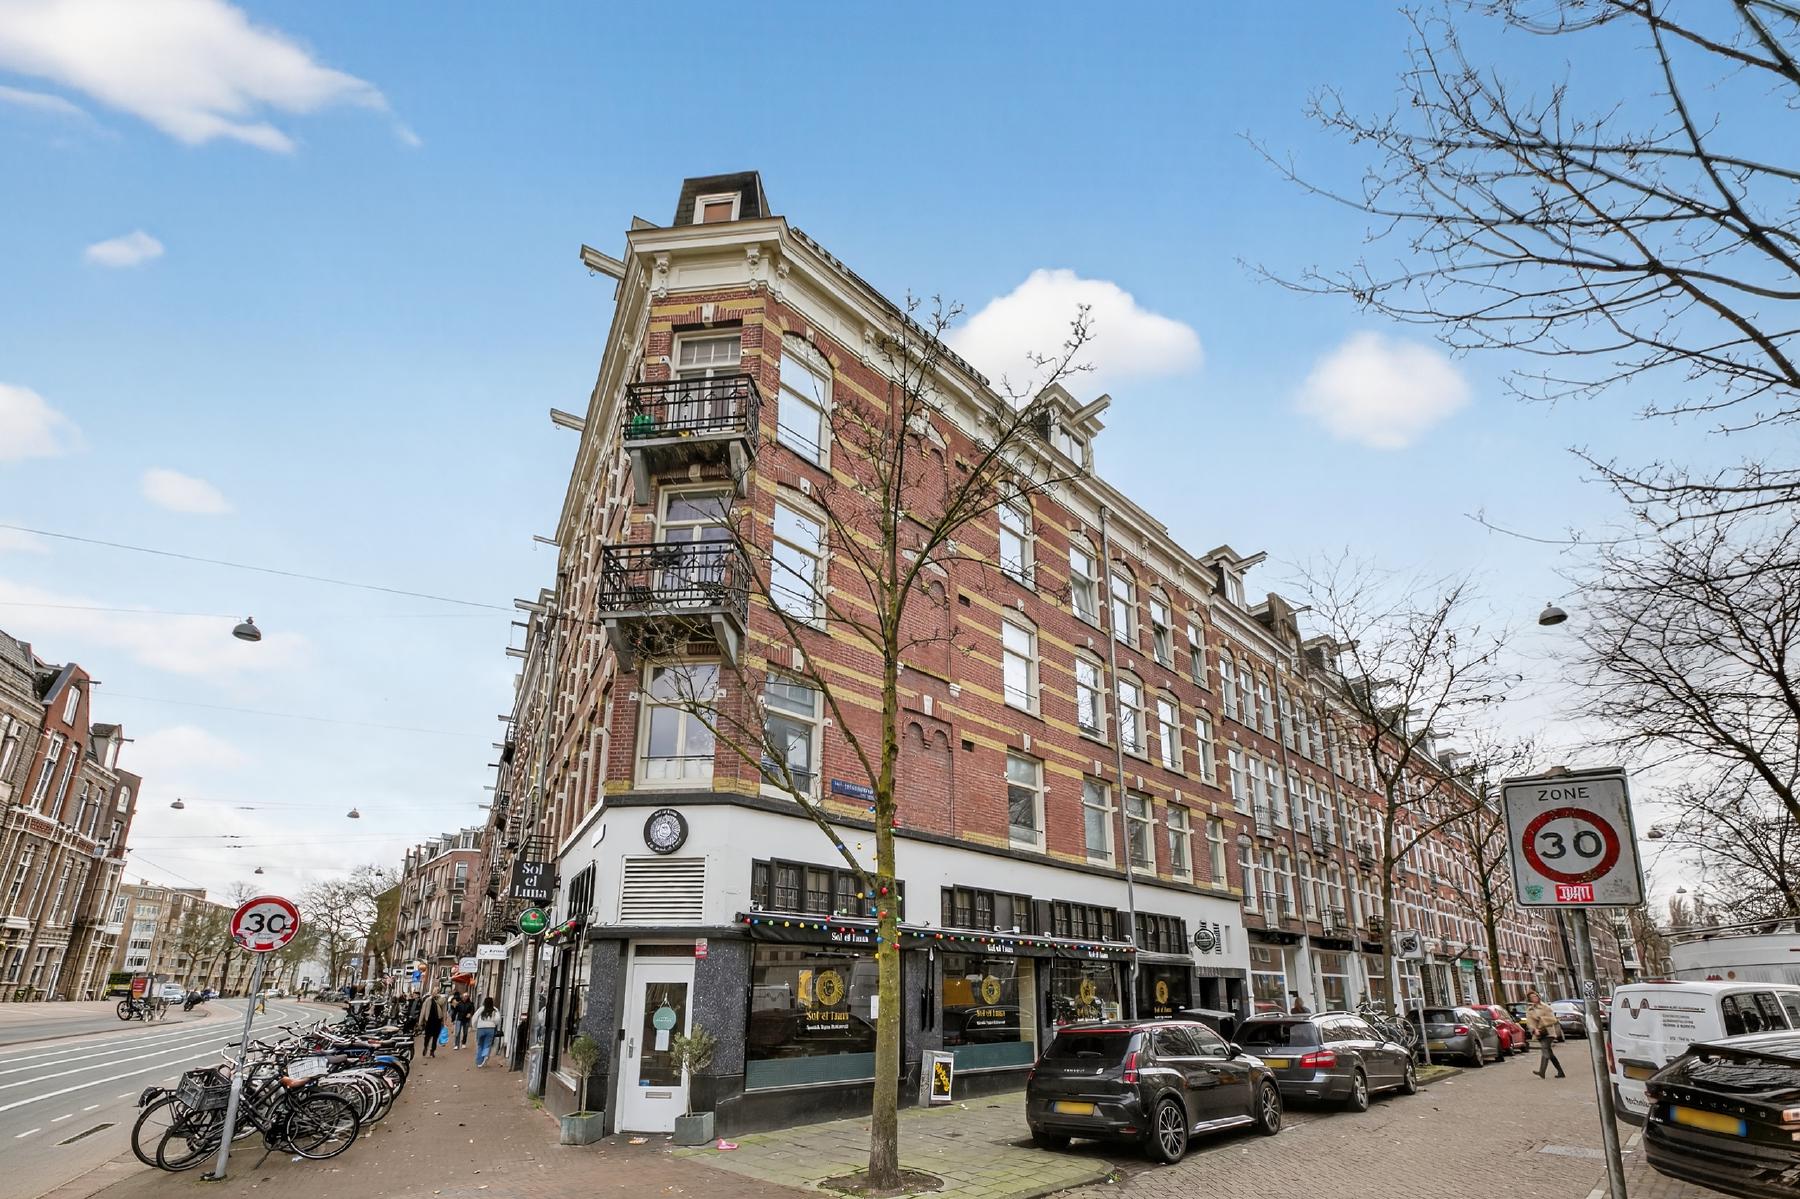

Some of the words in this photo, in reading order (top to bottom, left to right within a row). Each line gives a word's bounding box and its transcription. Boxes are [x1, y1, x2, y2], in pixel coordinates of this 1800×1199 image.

[1538, 787, 1590, 801] ZONE
[1539, 830, 1603, 860] 30
[522, 862, 543, 875] Sol
[525, 875, 537, 887] el
[514, 885, 547, 898] Luna
[244, 913, 287, 934] 30
[831, 931, 843, 942] Sol
